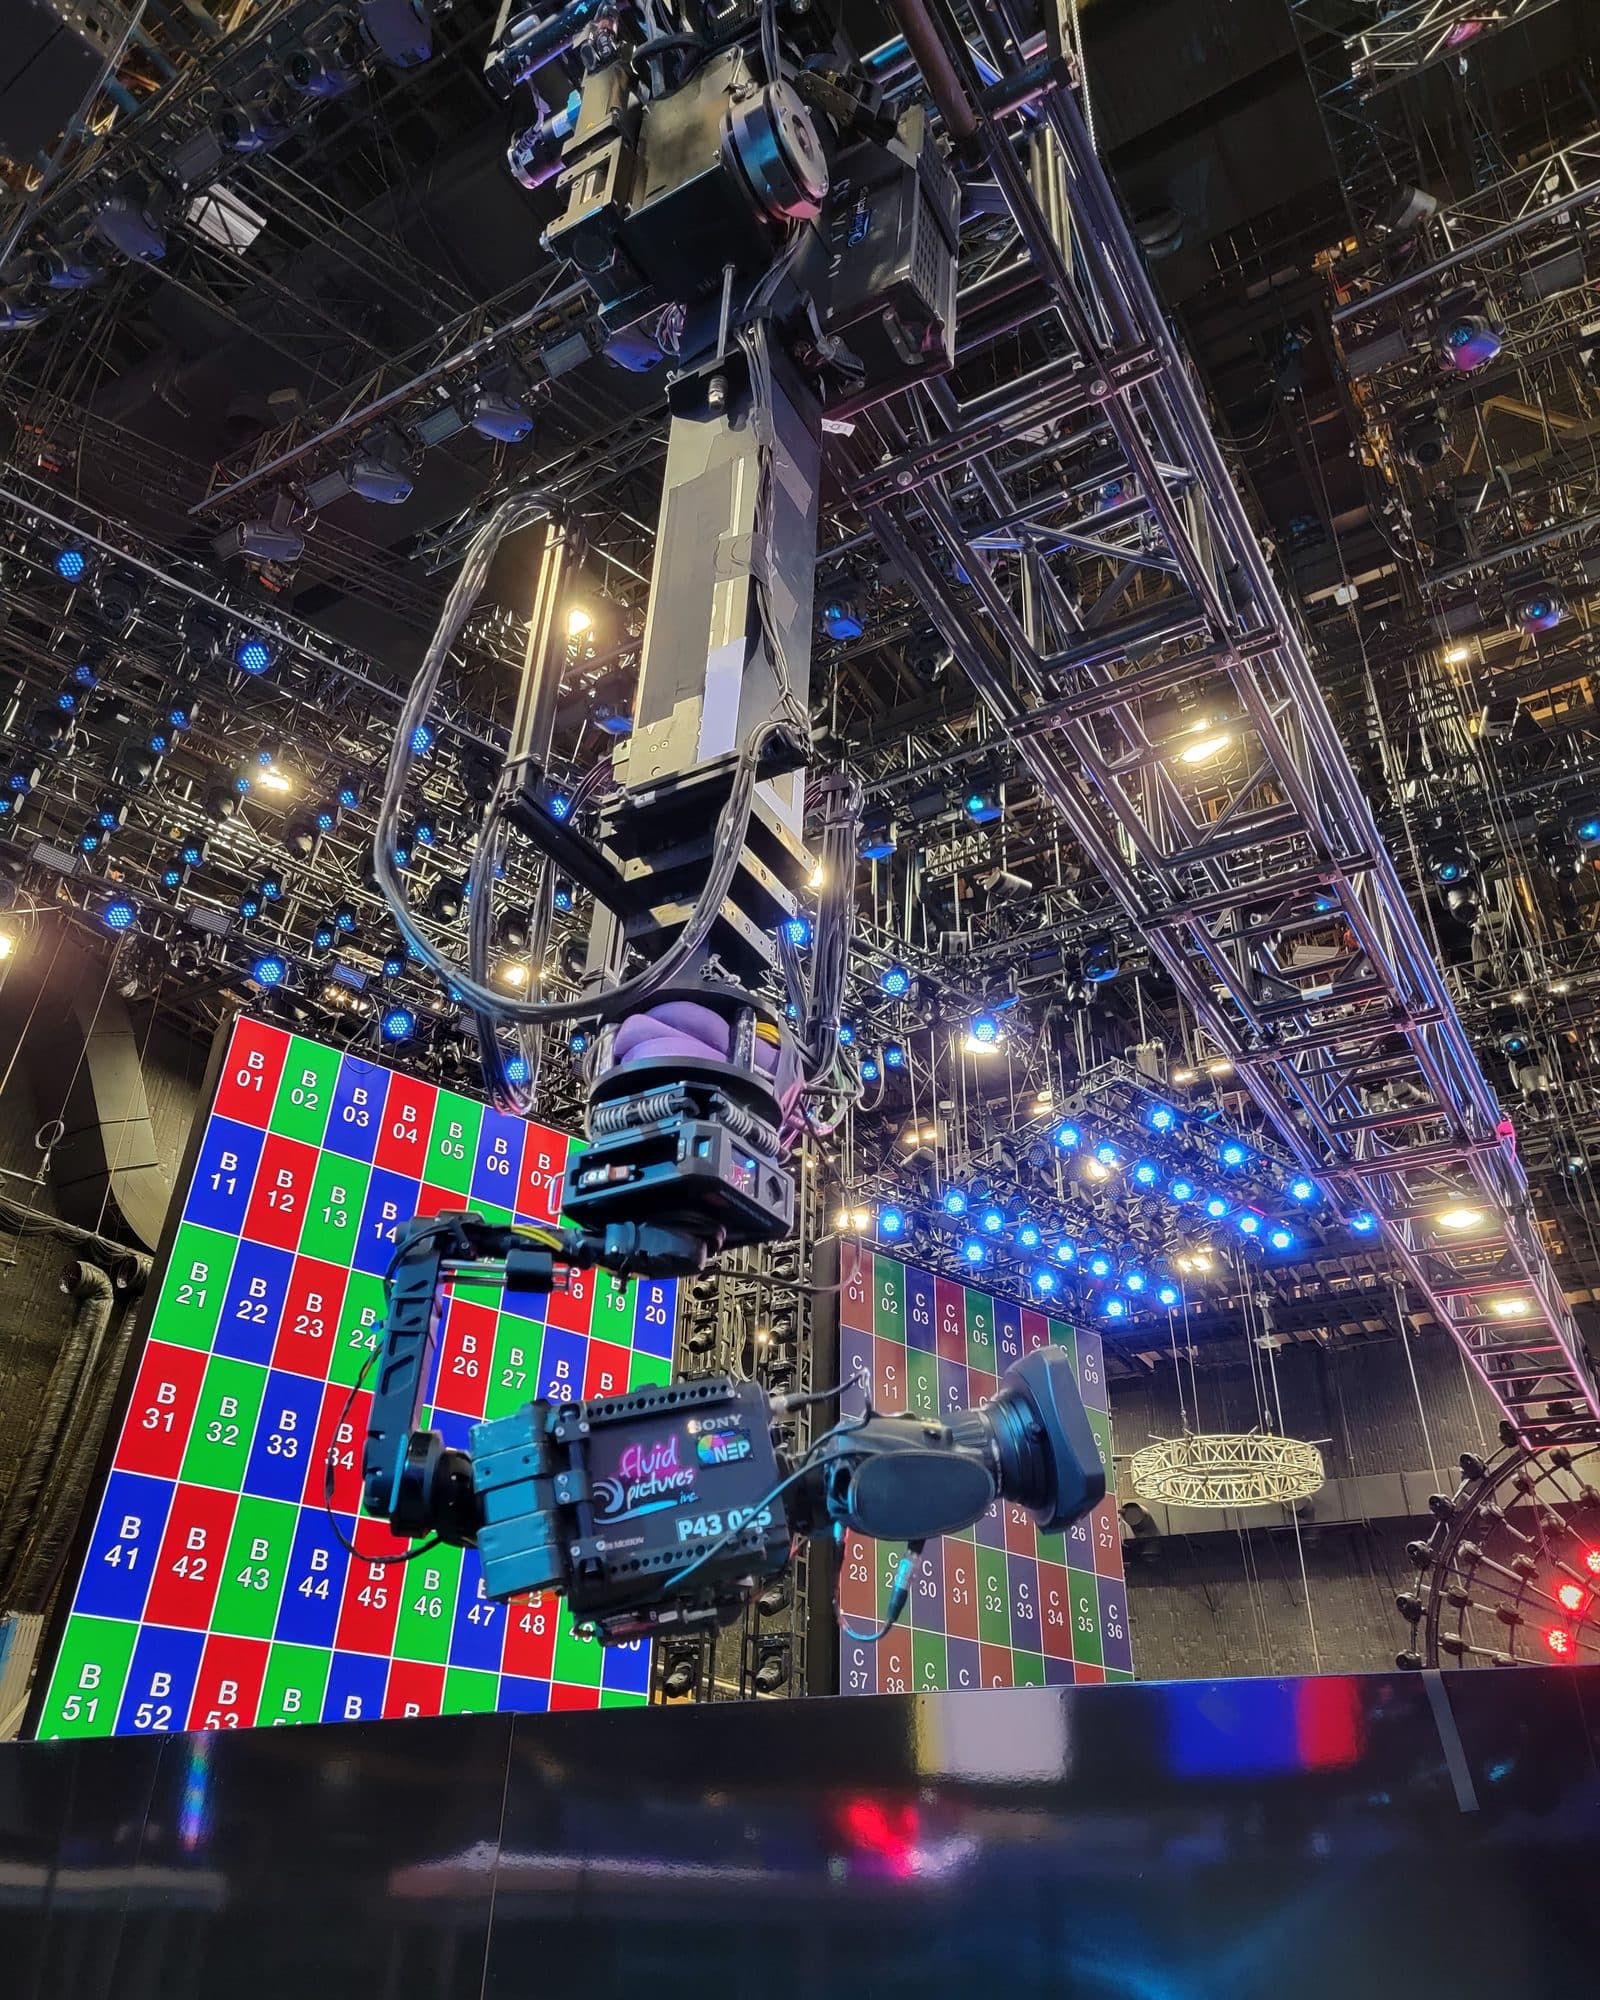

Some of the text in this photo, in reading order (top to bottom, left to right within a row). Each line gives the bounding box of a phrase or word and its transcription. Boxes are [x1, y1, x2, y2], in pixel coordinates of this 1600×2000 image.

[247, 1050, 265, 1070] B
[236, 1069, 263, 1092] 01
[301, 1069, 317, 1088] B
[290, 1088, 319, 1111] 02
[352, 1087, 369, 1106] B
[342, 1105, 370, 1128] 03
[402, 1104, 417, 1123] B
[392, 1122, 418, 1144] 04
[449, 1121, 463, 1139] B
[440, 1139, 465, 1160] 05
[494, 1137, 508, 1155] B
[219, 1151, 238, 1172] B
[486, 1155, 510, 1176] 06
[537, 1152, 551, 1170] B
[210, 1172, 237, 1195] 11
[276, 1168, 294, 1188] B
[530, 1172, 553, 1190] 07
[267, 1190, 295, 1213] 12
[330, 1185, 346, 1205] B
[322, 1206, 348, 1228] 13
[381, 1201, 398, 1221] B
[374, 1222, 398, 1244] 14
[189, 1261, 209, 1283] B
[852, 1271, 863, 1286] C
[175, 1284, 207, 1308] 21
[248, 1277, 267, 1298] B
[563, 1282, 584, 1301] 8
[651, 1286, 664, 1304] B
[848, 1286, 865, 1304] 01
[884, 1281, 895, 1296] C
[305, 1292, 323, 1313] B
[605, 1293, 626, 1312] 19
[881, 1297, 898, 1315] 02
[915, 1292, 926, 1307] C
[235, 1299, 268, 1324] 22
[360, 1307, 376, 1327] B
[644, 1304, 667, 1325] 20
[912, 1308, 929, 1325] 03
[945, 1303, 956, 1318] C
[293, 1314, 324, 1338] 23
[943, 1319, 959, 1336] 04
[975, 1314, 985, 1329] C
[1003, 1324, 1014, 1339] C
[348, 1329, 377, 1352] 24
[461, 1334, 477, 1354] B
[972, 1329, 989, 1346] 05
[1001, 1339, 1017, 1356] 06
[1031, 1335, 1041, 1348] C
[452, 1356, 479, 1378] 26
[510, 1347, 524, 1367] B
[851, 1354, 863, 1370] C
[1085, 1354, 1095, 1368] C
[501, 1368, 527, 1389] 27
[555, 1359, 570, 1379] B
[885, 1365, 896, 1381] C
[1083, 1369, 1099, 1385] 09
[547, 1380, 572, 1403] 28
[600, 1372, 613, 1391] B
[881, 1383, 899, 1400] 11
[917, 1376, 928, 1391] C
[156, 1382, 177, 1405] B
[914, 1393, 931, 1410] 12
[948, 1385, 959, 1401] C
[219, 1396, 238, 1418] B
[142, 1407, 175, 1433] 31
[278, 1409, 297, 1431] B
[689, 1414, 743, 1433] SONY
[206, 1421, 239, 1446] 32
[336, 1422, 354, 1444] B
[266, 1434, 298, 1458] 33
[713, 1441, 751, 1464] NEP
[324, 1446, 354, 1470] 34
[626, 1468, 694, 1510] pictures
[984, 1502, 998, 1518] 3
[1011, 1508, 1028, 1526] 24
[119, 1515, 142, 1540] B
[678, 1513, 723, 1541] P43
[1070, 1524, 1087, 1542] 26
[1100, 1515, 1110, 1531] C
[186, 1527, 207, 1551] B
[1098, 1532, 1114, 1549] 27
[104, 1544, 139, 1570] 41
[249, 1538, 269, 1561] B
[310, 1548, 329, 1571] B
[852, 1543, 864, 1561] C
[171, 1555, 208, 1581] 42
[887, 1551, 899, 1569] C
[921, 1559, 933, 1577] C
[236, 1566, 270, 1591] 43
[368, 1562, 386, 1581] B
[423, 1568, 440, 1590] B
[849, 1563, 868, 1583] 28
[955, 1567, 966, 1585] C
[298, 1576, 329, 1600] 44
[918, 1579, 937, 1599] 30
[987, 1575, 998, 1592] C
[1018, 1583, 1029, 1600] C
[357, 1585, 388, 1610] 45
[952, 1586, 968, 1606] 31
[984, 1594, 1003, 1613] 32
[1049, 1590, 1060, 1607] C
[1079, 1597, 1089, 1614] C
[413, 1595, 442, 1618] 46
[467, 1603, 496, 1627] 47
[1016, 1601, 1034, 1620] 33
[1108, 1603, 1119, 1620] C
[519, 1612, 546, 1636] 48
[1047, 1608, 1064, 1627] 34
[1077, 1615, 1094, 1633] 35
[1106, 1622, 1124, 1640] 36
[852, 1647, 865, 1667] C
[889, 1655, 901, 1674] C
[78, 1663, 102, 1689] B
[849, 1669, 869, 1690] 37
[924, 1662, 936, 1680] C
[958, 1668, 970, 1687] C
[149, 1671, 172, 1698] B
[217, 1680, 238, 1705] B
[885, 1675, 904, 1692] 38
[62, 1695, 99, 1723] 51
[282, 1688, 302, 1712] B
[343, 1695, 363, 1720] B
[134, 1703, 173, 1731] 52
[205, 1710, 239, 1730] 53
